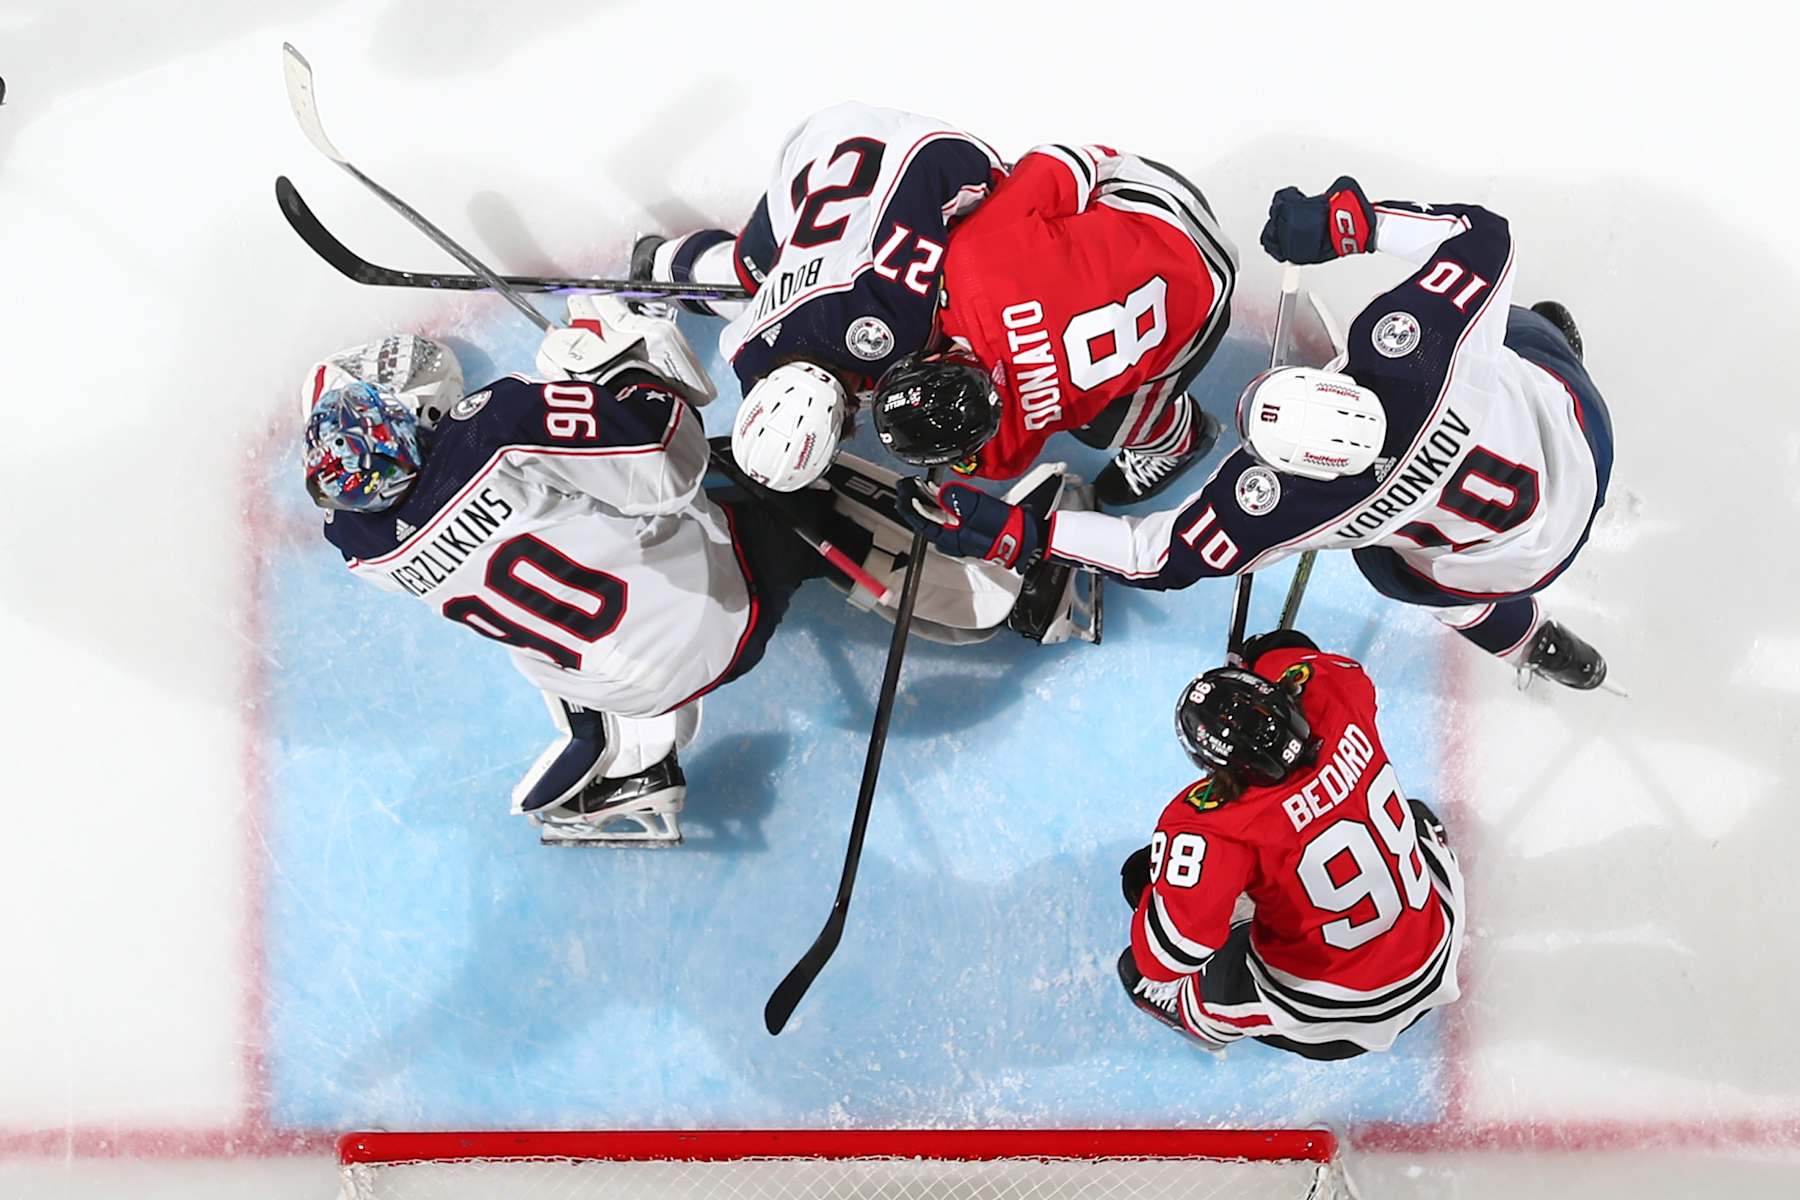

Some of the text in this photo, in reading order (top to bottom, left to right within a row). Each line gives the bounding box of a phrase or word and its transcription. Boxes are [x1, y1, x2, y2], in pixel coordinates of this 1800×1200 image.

[873, 223, 945, 297] 27
[1417, 258, 1491, 312] 10
[1003, 300, 1063, 431] DONATO
[1064, 276, 1168, 392] 8
[544, 382, 599, 440] 90
[1337, 407, 1471, 540] VORONKOV
[1180, 504, 1242, 571] 10
[442, 531, 629, 671] 90
[1189, 681, 1213, 704] 98
[1282, 739, 1302, 764] 98
[1282, 723, 1375, 833] BEDARD
[1150, 831, 1207, 887] 98
[1297, 763, 1433, 951] 98
